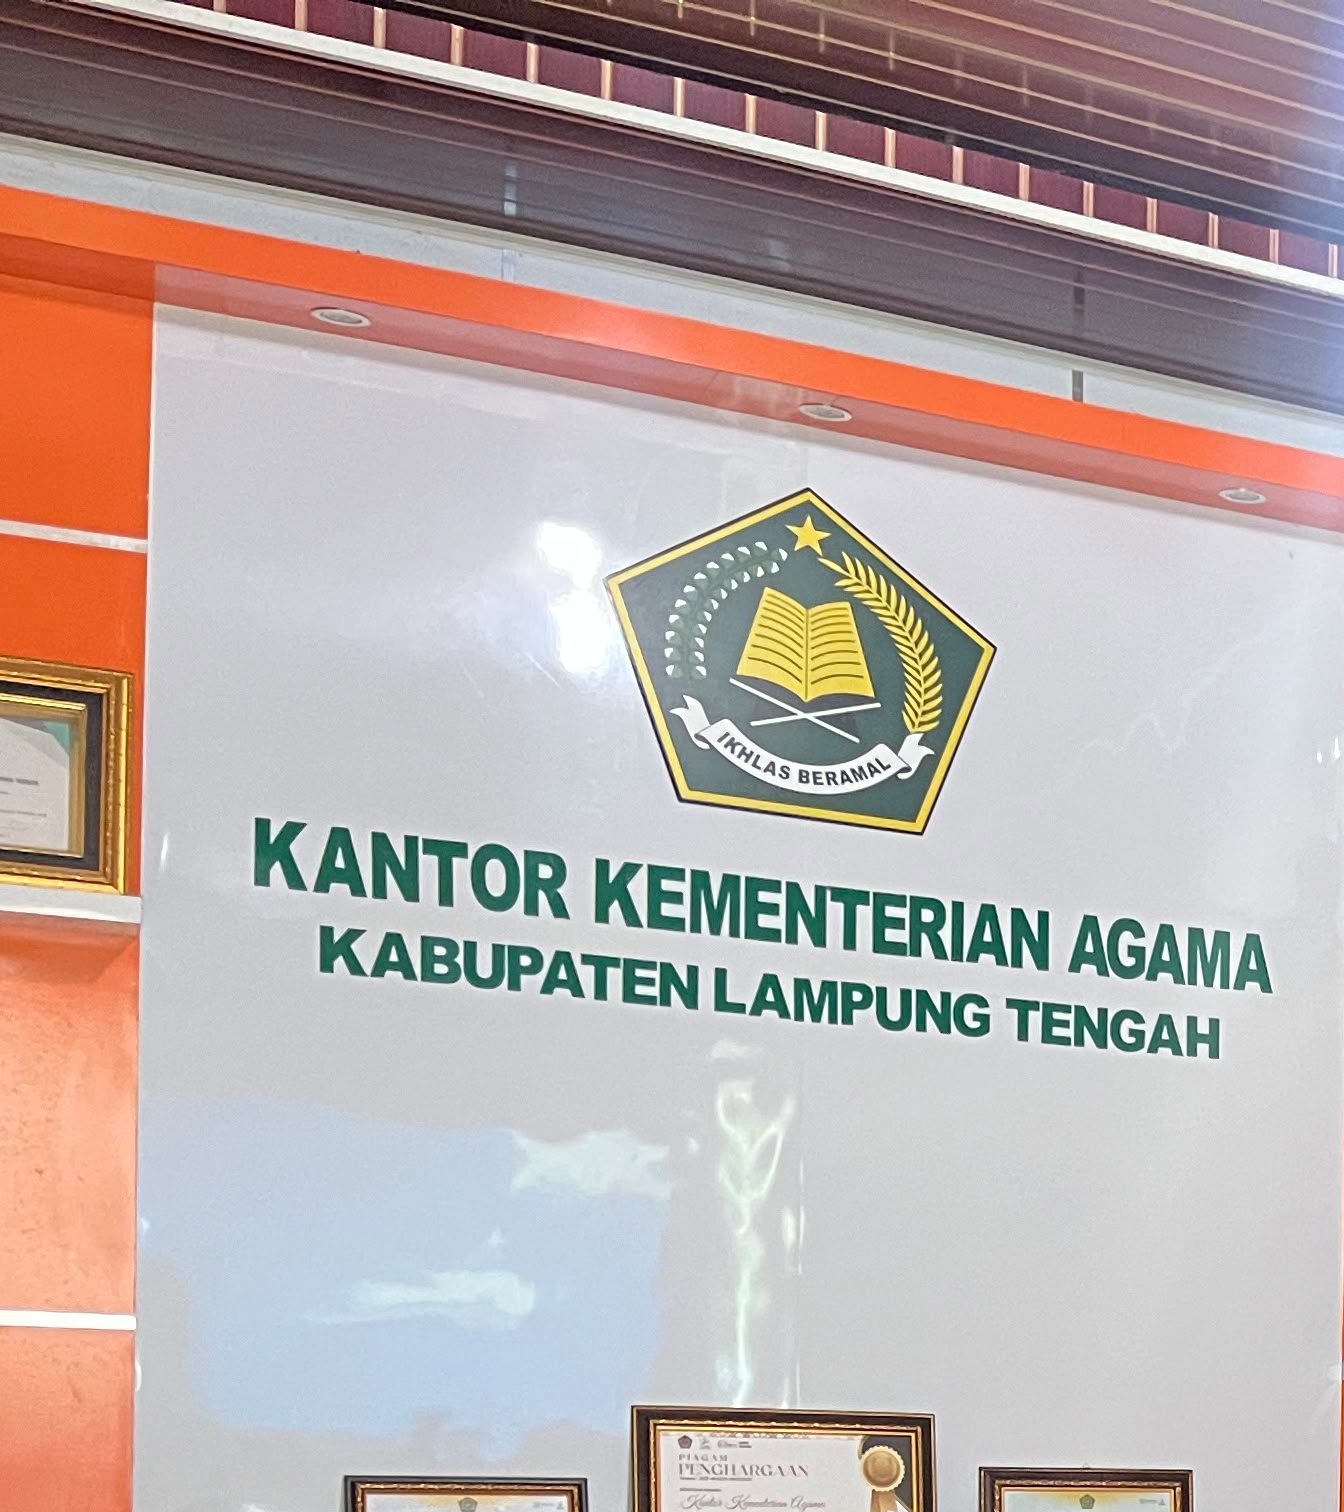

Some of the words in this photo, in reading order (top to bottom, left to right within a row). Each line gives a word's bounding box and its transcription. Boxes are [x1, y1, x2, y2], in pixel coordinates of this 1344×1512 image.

[717, 731, 791, 780] IKHLAS
[798, 757, 892, 787] BERAMAL
[254, 816, 570, 920] KANTOR
[595, 857, 1050, 972] KEMENTERIAN
[1068, 914, 1274, 994] AGAMA
[319, 924, 699, 1008] KABUPATEN
[713, 967, 991, 1038] LAMPUNG
[1005, 997, 1220, 1060] TENGAH
[678, 1463, 809, 1477] PENGHARGAAN
